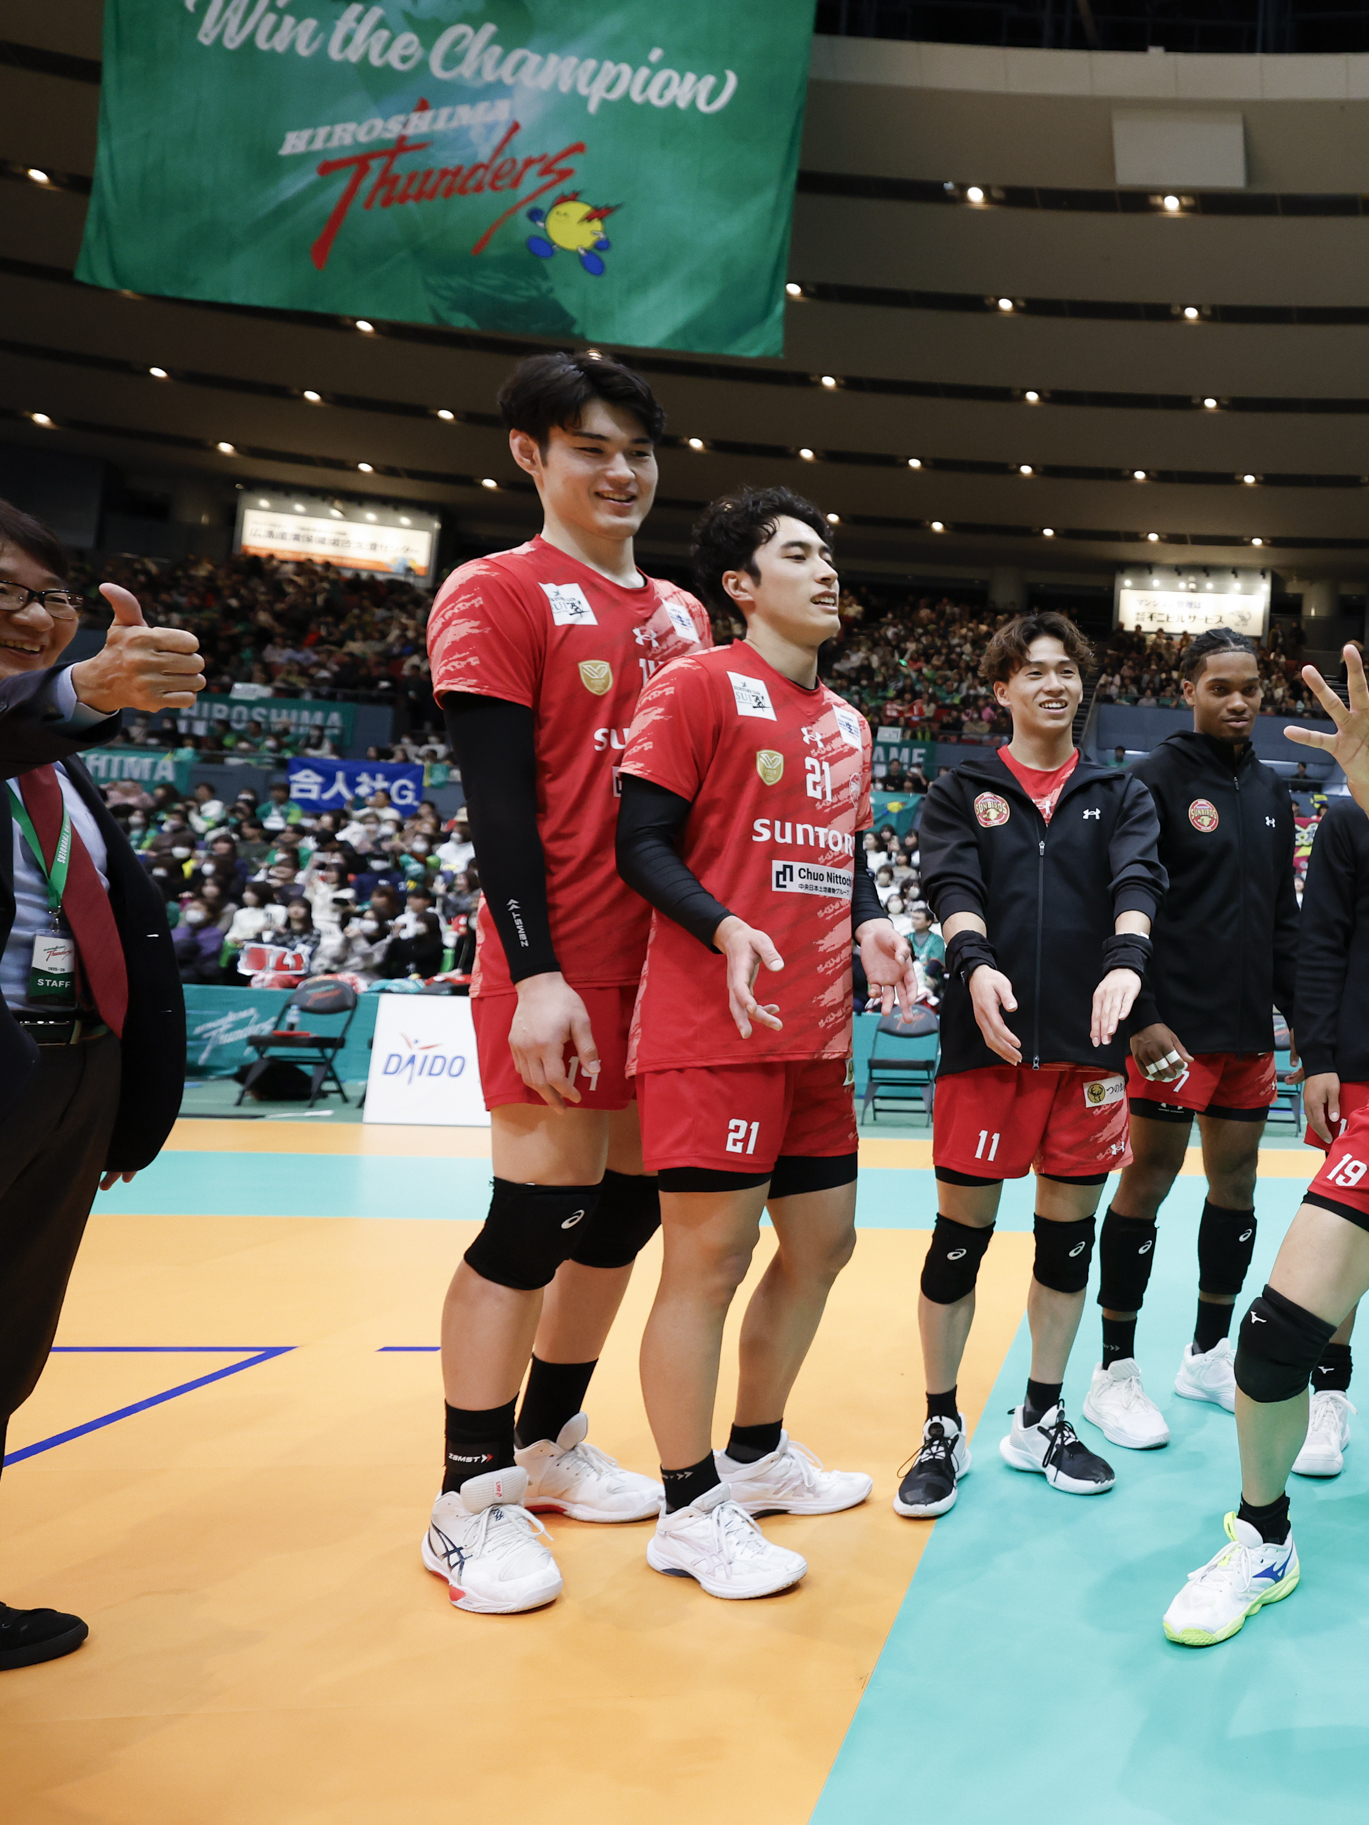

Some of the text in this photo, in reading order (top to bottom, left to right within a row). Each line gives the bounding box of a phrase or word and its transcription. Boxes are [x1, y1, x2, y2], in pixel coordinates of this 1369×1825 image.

[184, 0, 738, 114] Win the Champion
[278, 99, 513, 156] HIROSHIMA
[309, 97, 587, 270] Thunders
[79, 752, 175, 781] HIMA
[804, 756, 834, 803] 21
[975, 801, 1008, 816] SUNBIRDS
[752, 818, 855, 857] SUNTOR
[798, 867, 825, 882] Chuo
[37, 978, 71, 989] STAFF
[382, 1053, 466, 1086] DAIDO
[1173, 1070, 1190, 1092] 7
[726, 1117, 759, 1155] 21
[974, 1129, 1000, 1162] 11
[1326, 1152, 1368, 1187] 19
